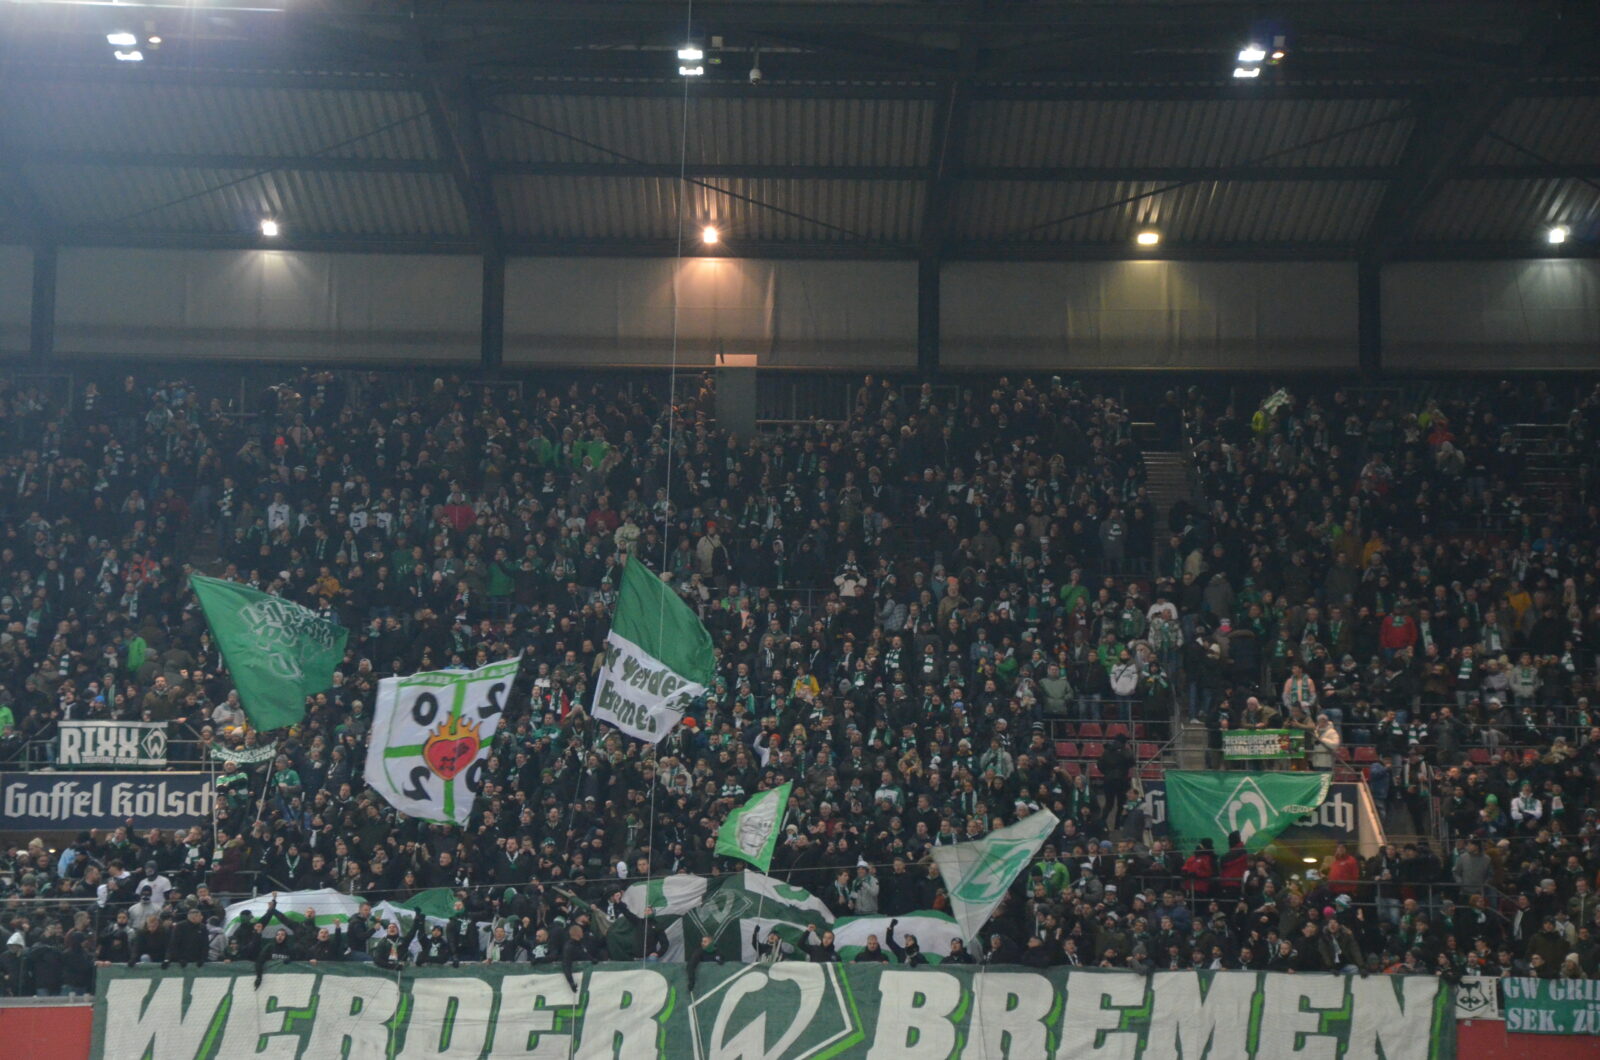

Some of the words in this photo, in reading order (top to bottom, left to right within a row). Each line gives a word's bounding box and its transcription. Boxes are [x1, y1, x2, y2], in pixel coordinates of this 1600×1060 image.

[61, 727, 139, 765] RIXX
[4, 781, 105, 820] Gaffel
[111, 781, 218, 818] Kölsch
[1502, 977, 1540, 999] GW
[1549, 978, 1600, 1000] GRI
[104, 969, 669, 1060] WERDER
[864, 969, 1440, 1060] BREMEN
[1507, 1007, 1564, 1032] SEK.
